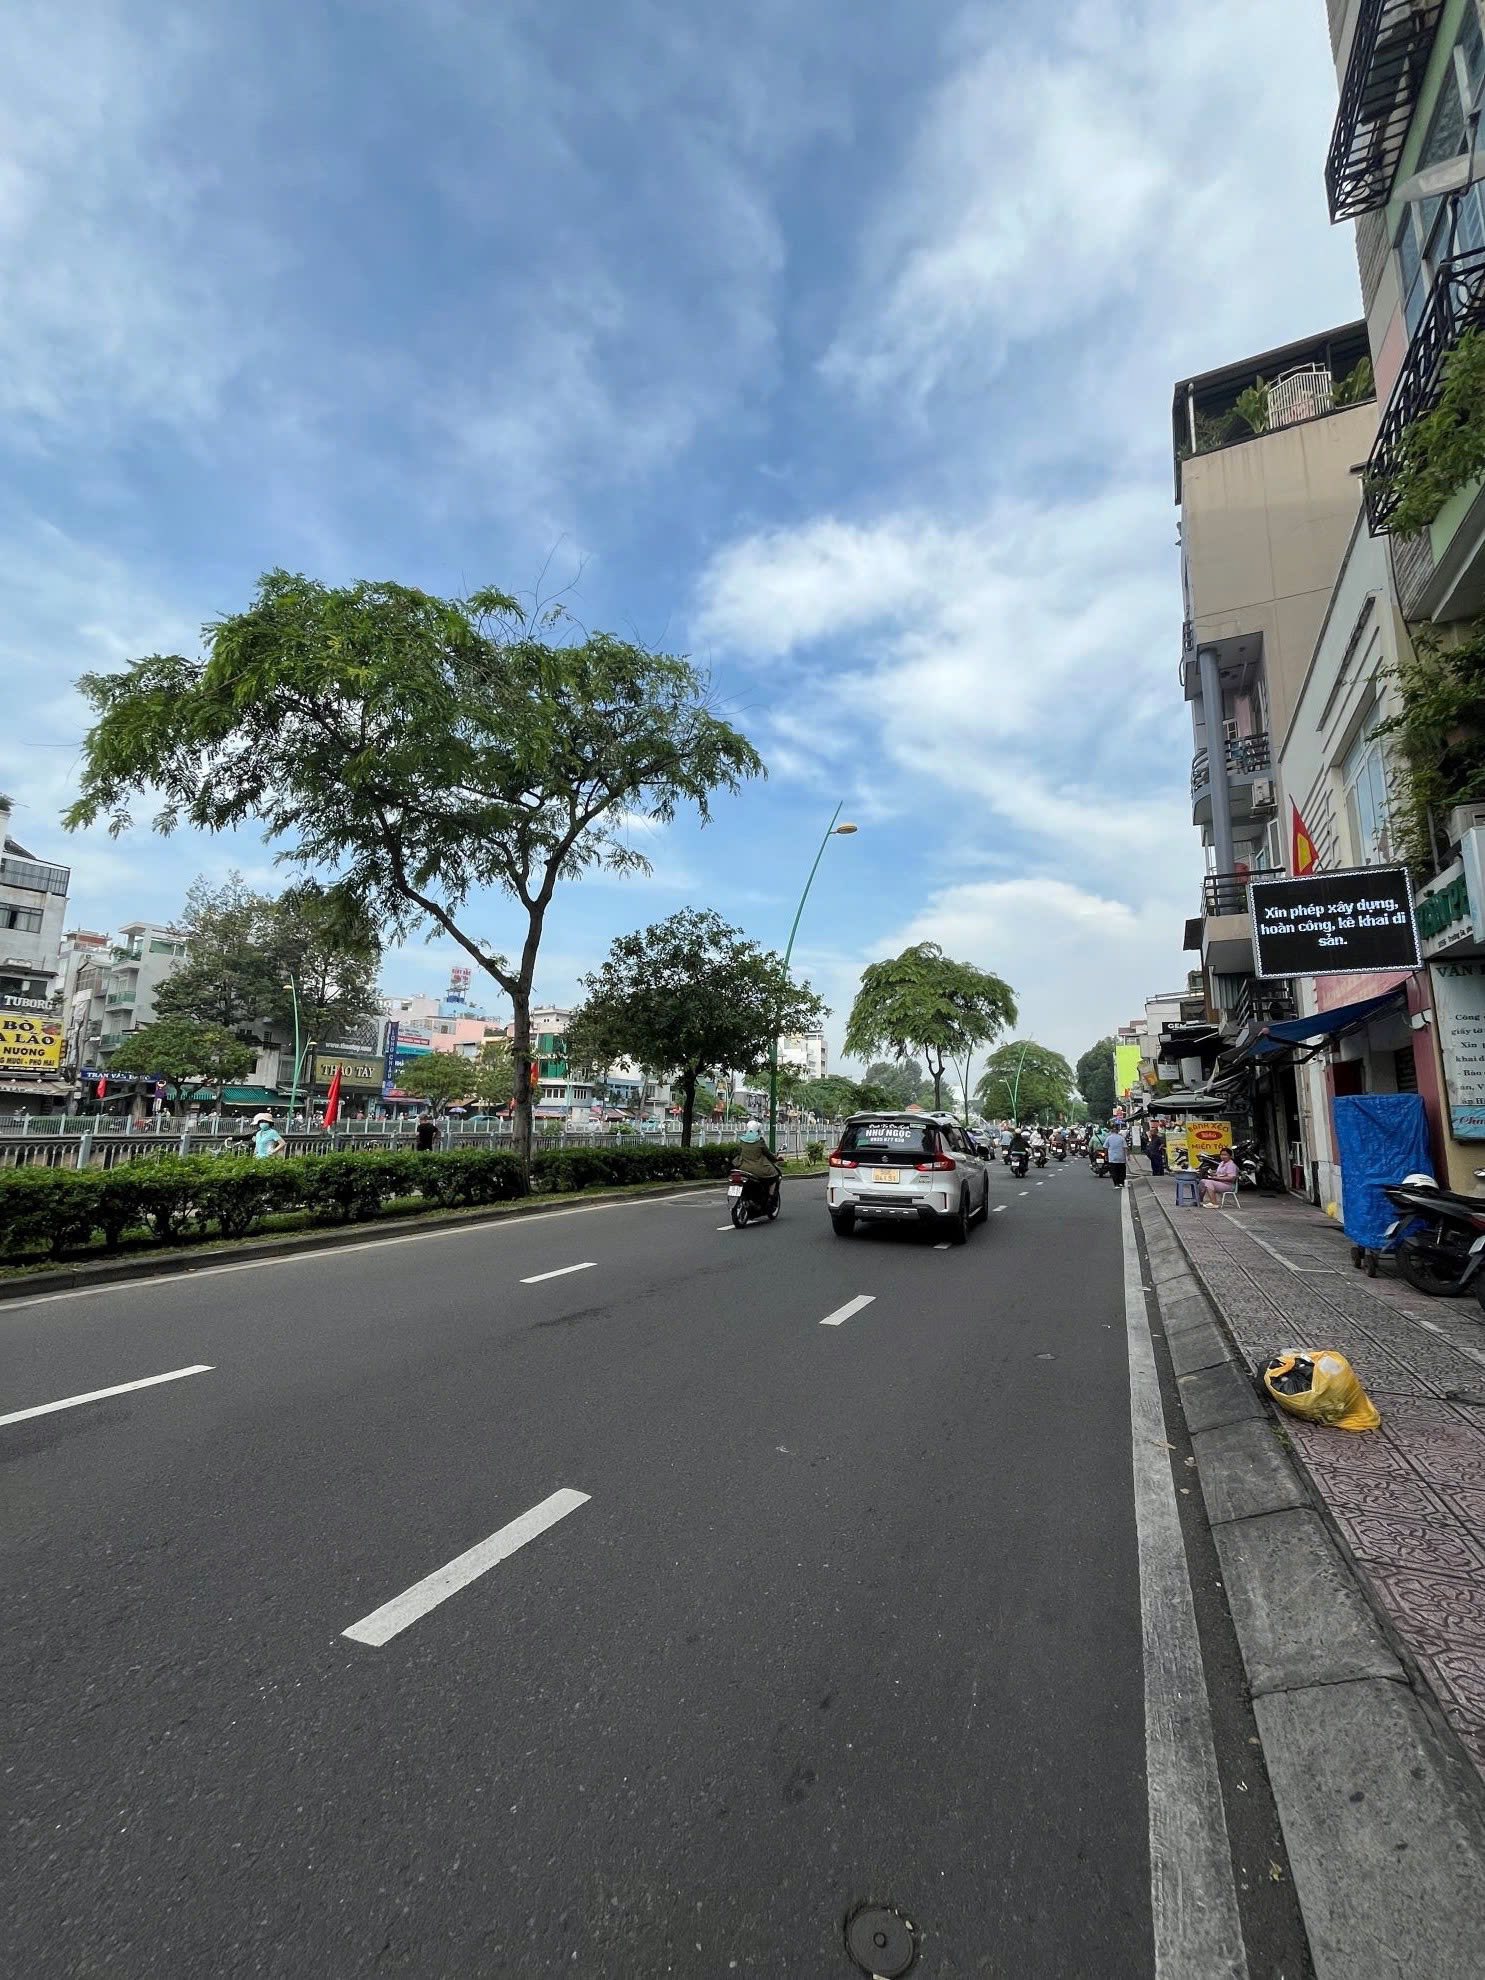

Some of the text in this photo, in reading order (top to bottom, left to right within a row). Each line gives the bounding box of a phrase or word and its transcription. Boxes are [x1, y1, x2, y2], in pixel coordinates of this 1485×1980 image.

[1264, 898, 1399, 919] Xin phép xây dụng,
[1261, 923, 1295, 936] hoàn
[1298, 920, 1335, 933] công,
[1338, 917, 1356, 929] kê
[1358, 914, 1389, 927] khai
[1318, 934, 1348, 947] sản.
[4, 995, 54, 1009] TUBORG
[3, 1019, 35, 1031] BÒ
[865, 1129, 912, 1138] NHƯ NGỌC
